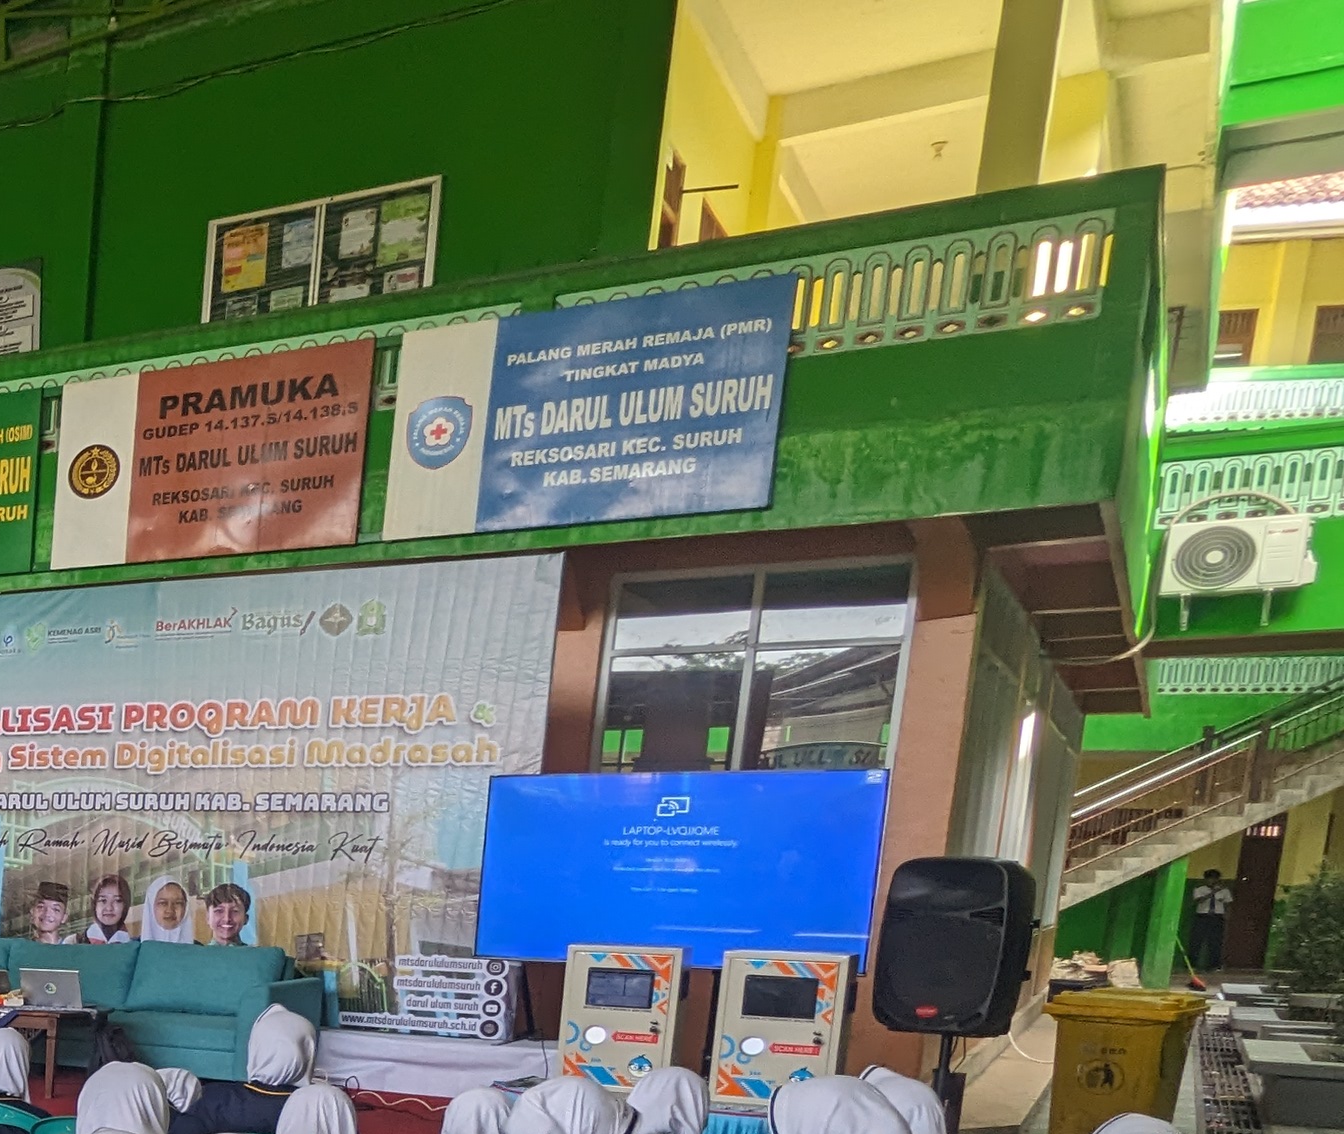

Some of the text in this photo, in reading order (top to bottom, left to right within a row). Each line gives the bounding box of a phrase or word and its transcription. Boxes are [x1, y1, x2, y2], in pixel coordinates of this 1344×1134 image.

[507, 317, 772, 367] PALANG MERAH REMAJA (PMR)
[563, 352, 705, 382] TINGKAT MADYA
[159, 373, 340, 420] PRAMUKA
[494, 374, 774, 441] MTs DARUL ULUM SURUH
[5, 424, 33, 443] (OSIM)
[143, 422, 200, 441] GUDEP
[139, 455, 170, 477] MTs
[176, 447, 231, 473] DARUL
[294, 432, 358, 461] SURUH
[510, 428, 742, 467] REKSOSARI KEC. SURUH
[281, 475, 334, 493] SURUH
[587, 457, 696, 483] SEMARANG
[155, 616, 232, 632] BerAKHLAK
[329, 694, 457, 732] KERJA
[470, 703, 495, 727] &
[9, 743, 108, 769] Sistem
[115, 738, 297, 775] Digitalisasi
[305, 735, 500, 767] Madrasah
[53, 793, 112, 811] ULUM
[115, 792, 191, 811] SURUH
[194, 792, 250, 812] KAB.
[254, 792, 390, 812] SEMARANG
[92, 828, 149, 856] Murid
[235, 829, 318, 859] Indonesia
[406, 995, 478, 1011] darul ulum suruh
